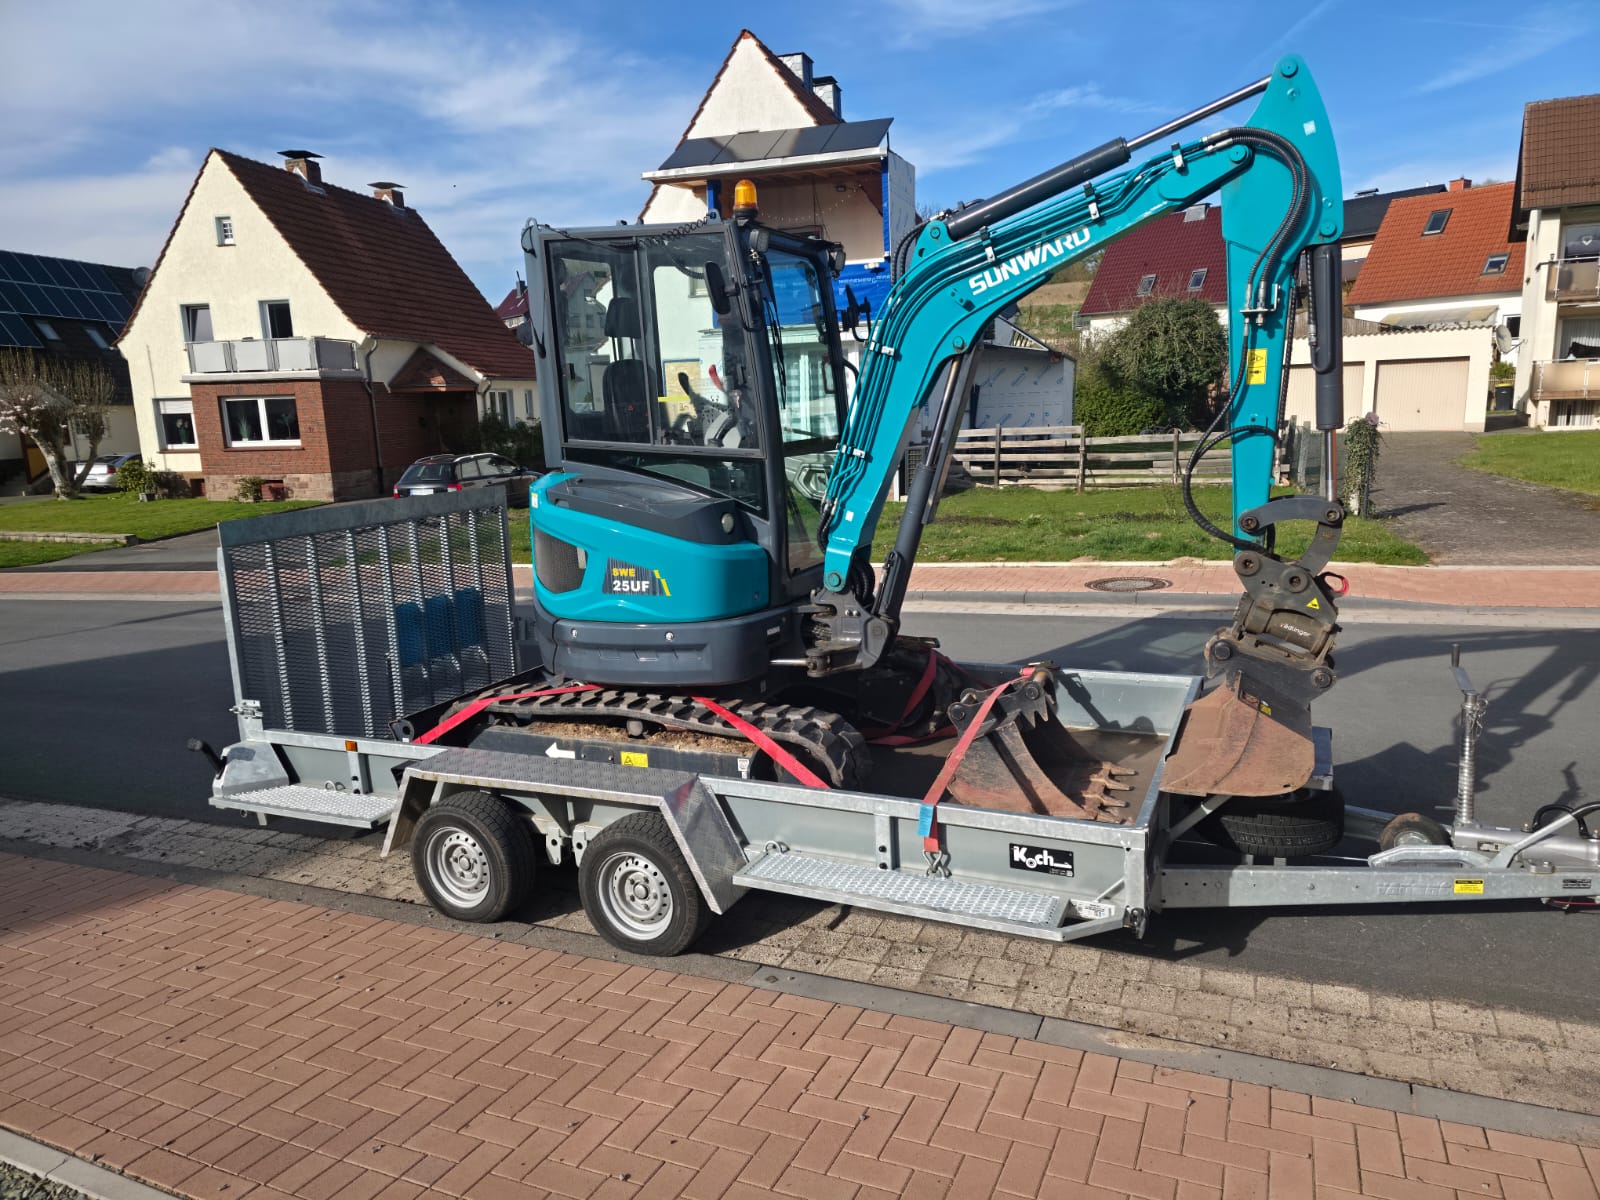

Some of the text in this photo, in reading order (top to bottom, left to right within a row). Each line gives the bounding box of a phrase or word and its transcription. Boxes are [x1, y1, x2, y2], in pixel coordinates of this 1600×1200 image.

[968, 226, 1091, 296] SUNWARD
[613, 580, 650, 592] 25UF
[1013, 846, 1054, 868] Koch
